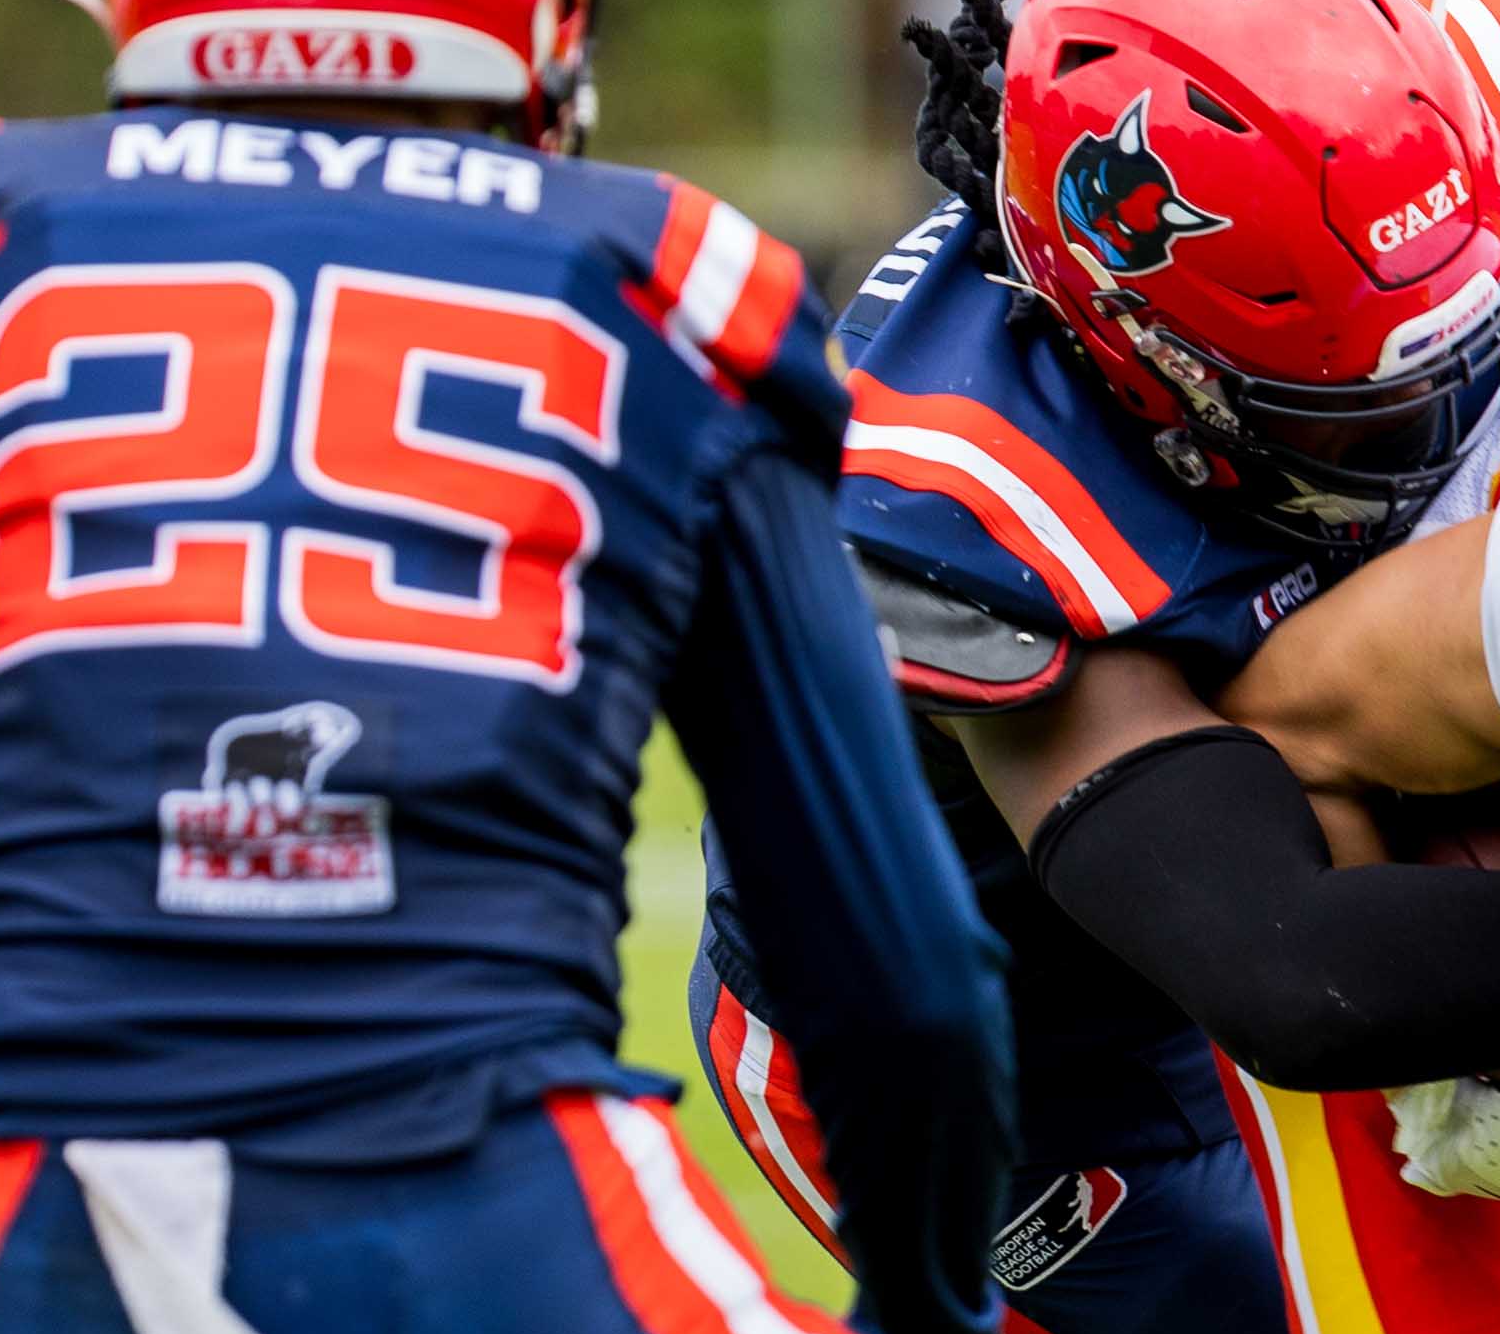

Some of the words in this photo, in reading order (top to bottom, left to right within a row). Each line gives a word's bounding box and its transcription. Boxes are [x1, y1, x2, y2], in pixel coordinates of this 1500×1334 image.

[204, 30, 393, 84] GAZI
[105, 119, 544, 215] MEYER
[1368, 168, 1470, 253] GAZI
[990, 1216, 1047, 1262] UROPEAN
[995, 1240, 1040, 1274] LEAGUE
[1003, 1240, 1064, 1284] FOOTBALL
